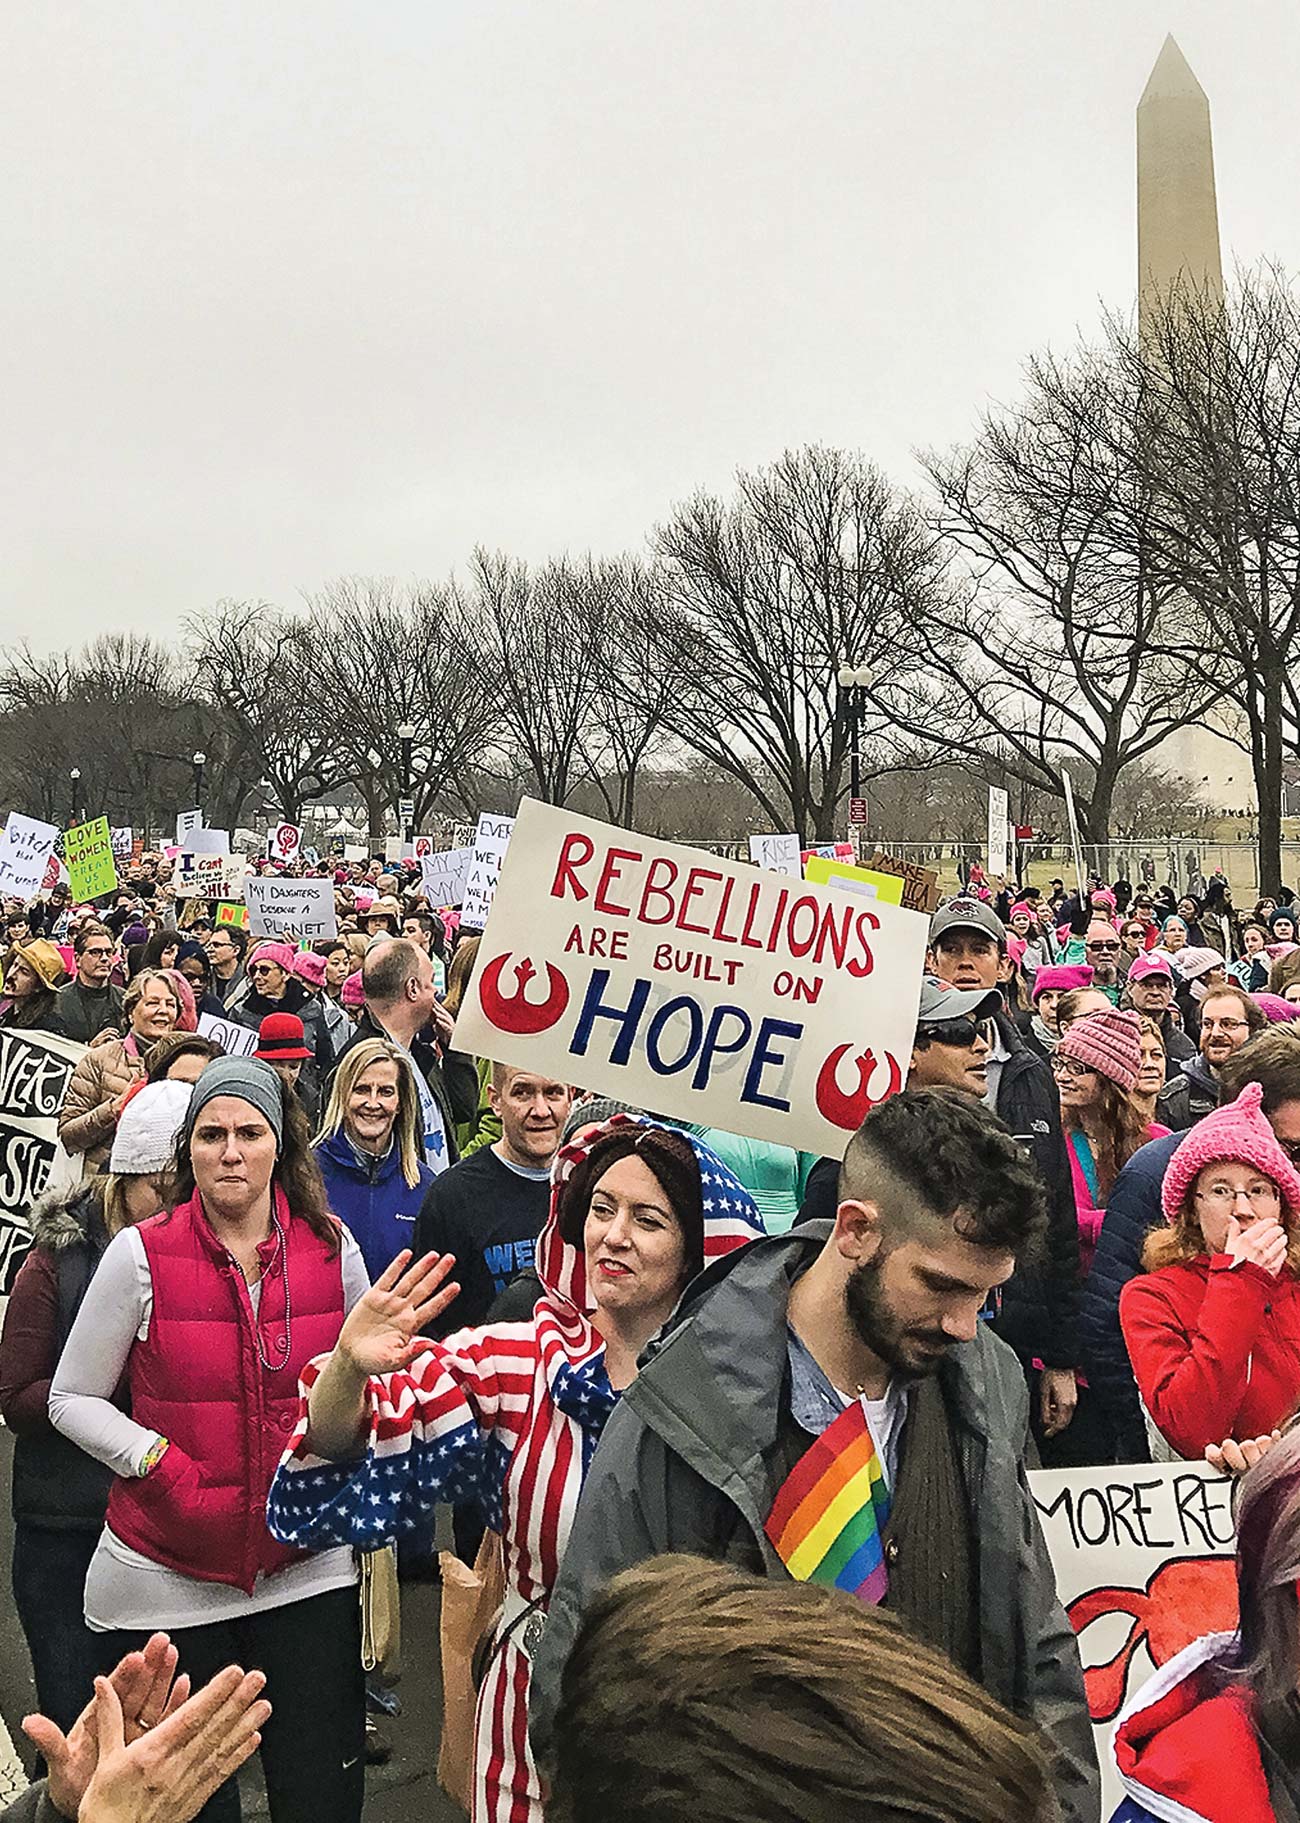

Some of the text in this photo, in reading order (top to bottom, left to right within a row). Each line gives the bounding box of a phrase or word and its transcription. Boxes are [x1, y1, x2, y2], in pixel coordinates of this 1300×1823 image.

[67, 820, 103, 846] LOVE
[69, 839, 109, 865] WOMEN
[475, 850, 495, 865] WE
[761, 838, 796, 863] RISE
[73, 857, 110, 877] TREAT
[178, 853, 195, 872] I
[423, 854, 448, 874] MY
[878, 855, 926, 881] MAKE
[84, 873, 99, 884] US
[78, 881, 108, 898] WELL
[249, 883, 265, 901] MY
[423, 880, 455, 907] MY
[301, 904, 310, 914] A
[465, 901, 474, 912] A
[550, 832, 881, 978] REBELLIONS
[263, 918, 326, 935] PLANET
[564, 924, 823, 1004] ARE BUILT ON
[569, 968, 804, 1113] HOPE
[1033, 1478, 1174, 1550] MORE
